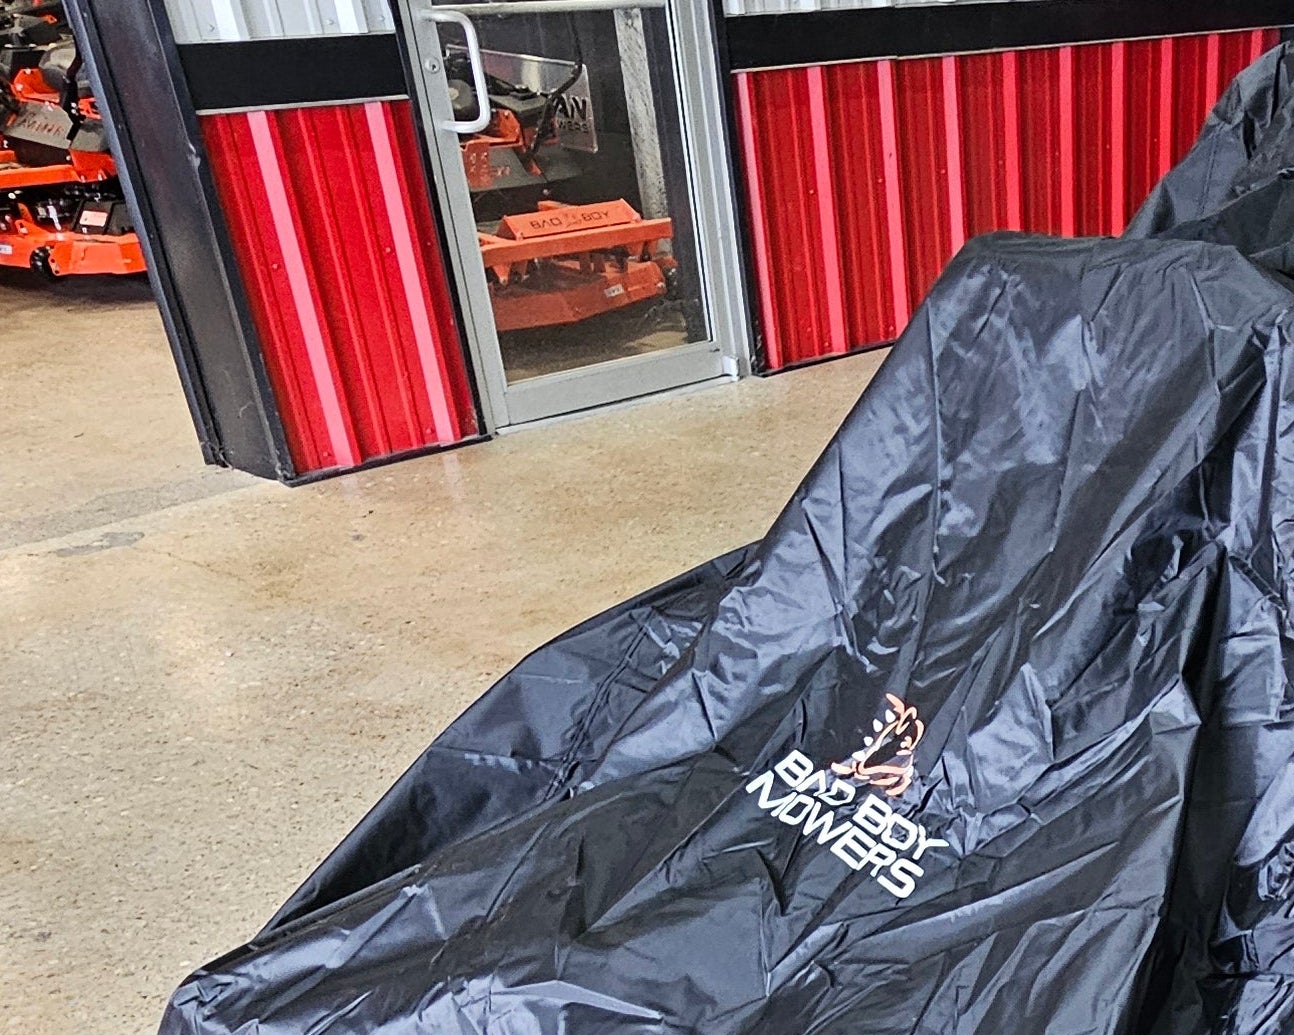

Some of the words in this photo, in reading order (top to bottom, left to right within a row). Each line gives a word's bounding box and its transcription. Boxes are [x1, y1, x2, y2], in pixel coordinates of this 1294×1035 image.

[530, 217, 563, 230] BAD
[581, 210, 609, 222] BOY
[745, 769, 925, 899] MOWERS
[774, 749, 856, 806] BAD
[852, 793, 950, 860] BOY
